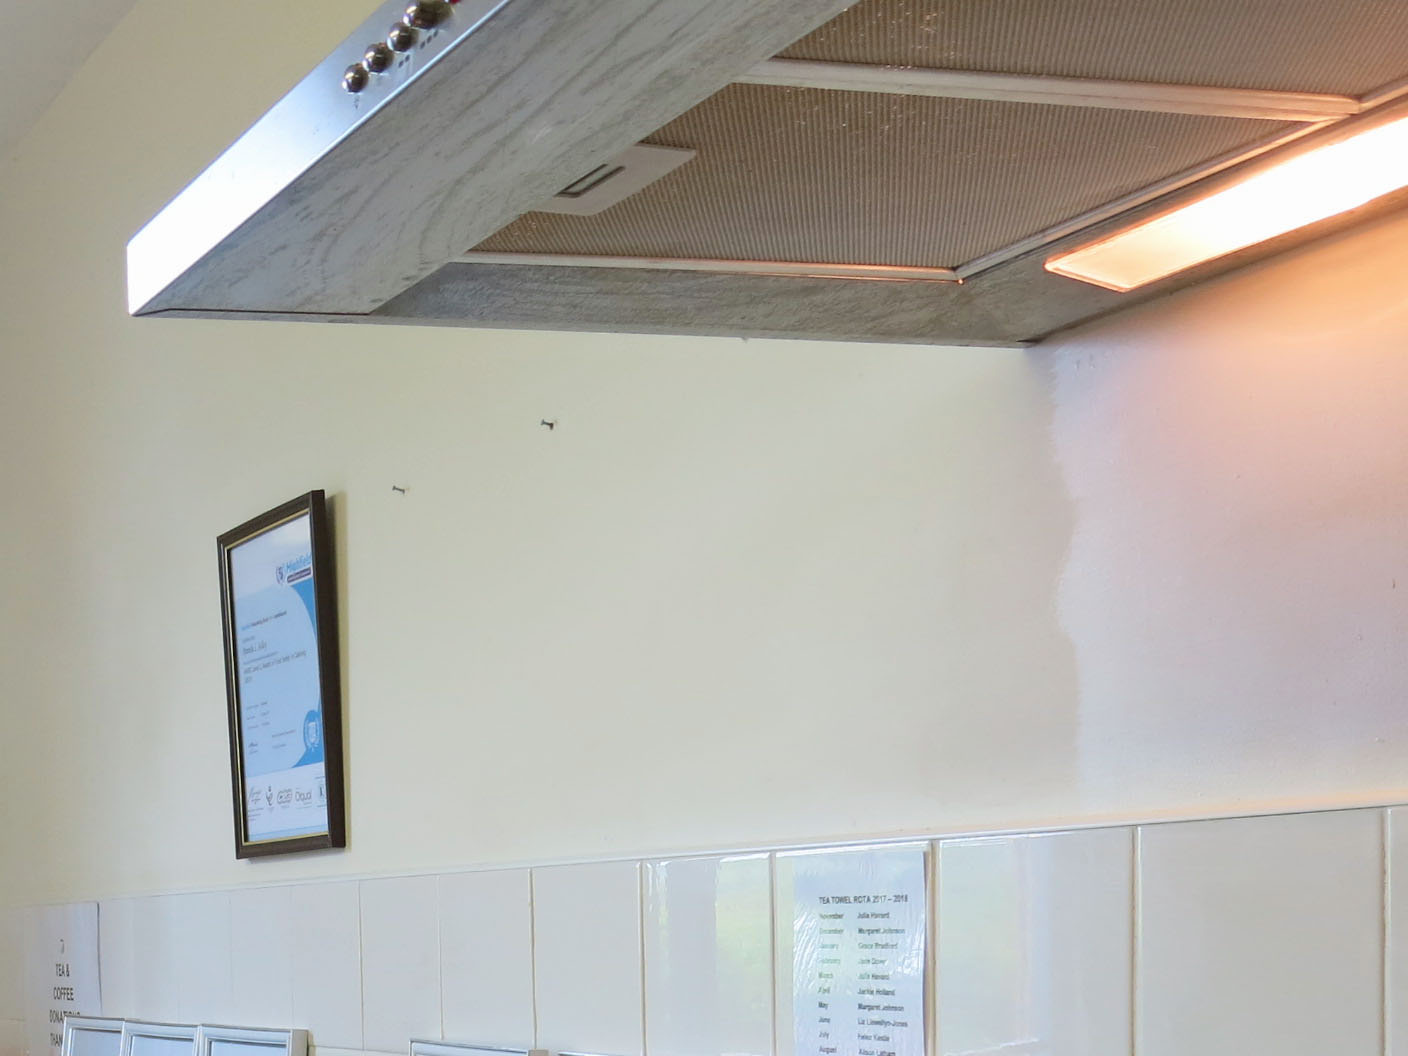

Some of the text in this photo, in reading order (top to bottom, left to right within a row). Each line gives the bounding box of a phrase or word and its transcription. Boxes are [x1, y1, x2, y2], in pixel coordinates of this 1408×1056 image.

[818, 895, 831, 905] TEA
[831, 895, 853, 905] TOWEL
[853, 894, 872, 904] ROTA
[872, 894, 887, 904] 2017
[893, 893, 908, 903] 2018
[55, 963, 70, 977] TEA &
[53, 986, 74, 1001] COFFEE
[818, 1001, 829, 1010] May
[818, 1031, 830, 1040] July
